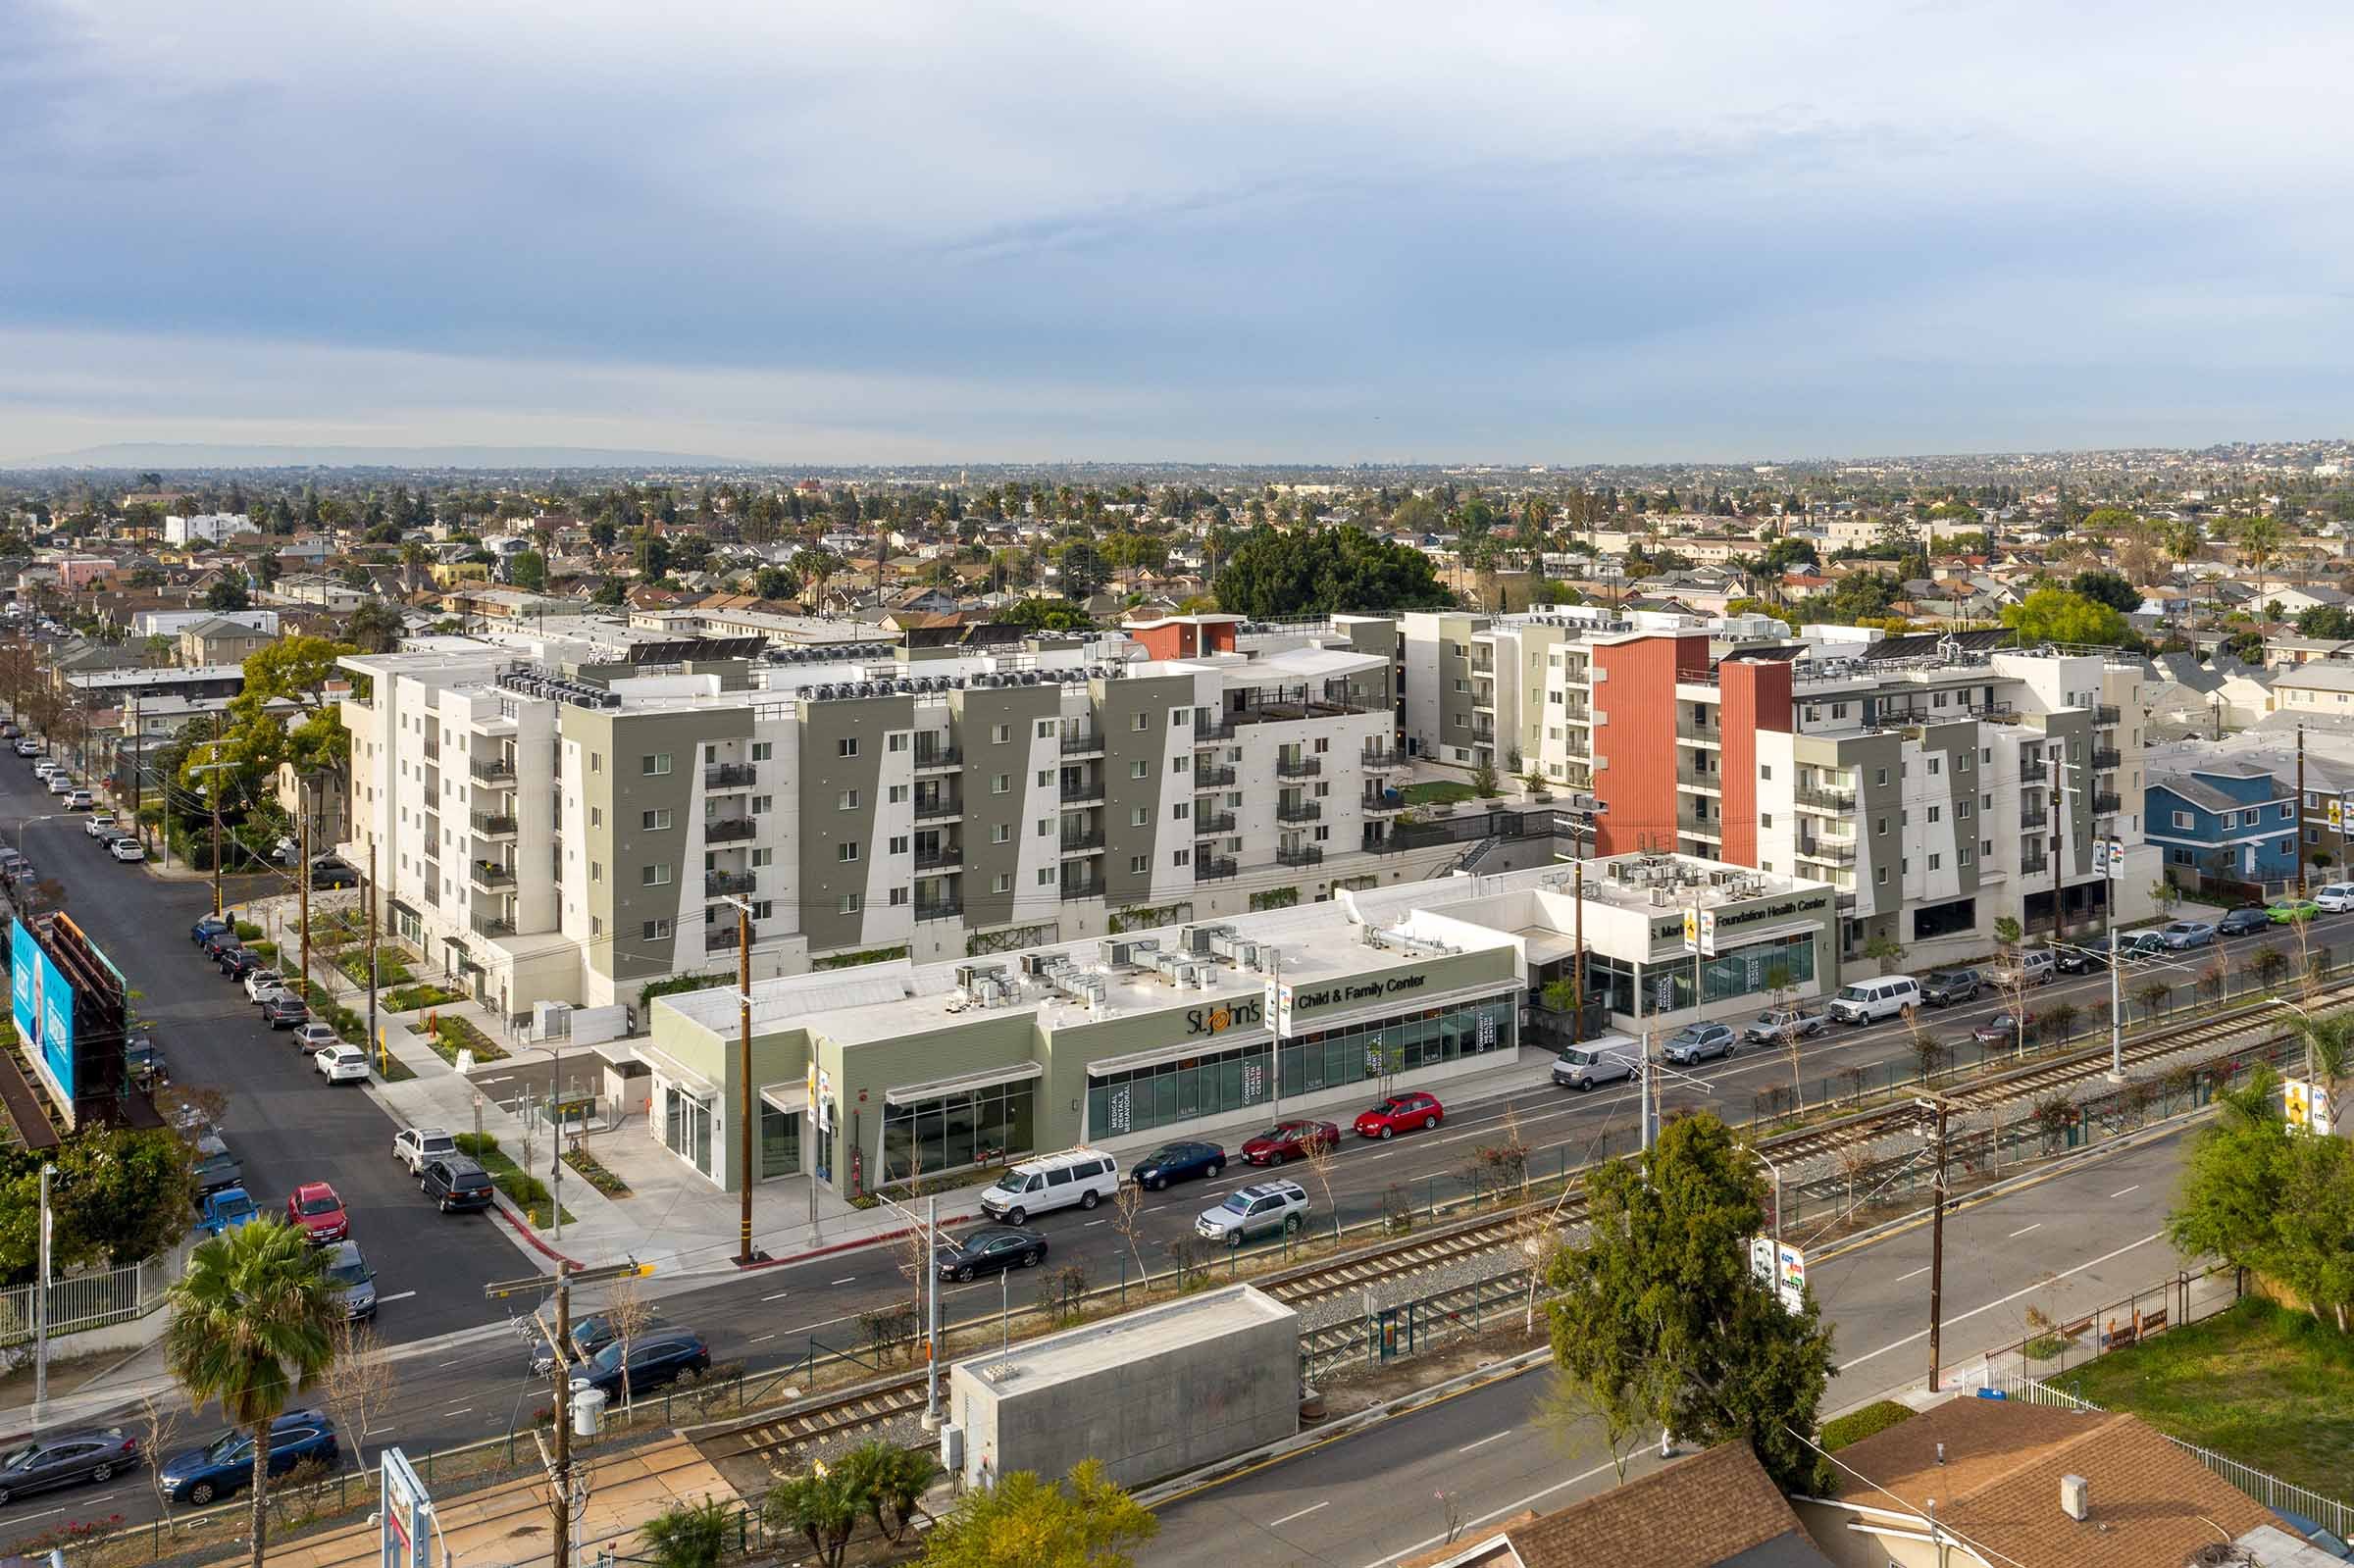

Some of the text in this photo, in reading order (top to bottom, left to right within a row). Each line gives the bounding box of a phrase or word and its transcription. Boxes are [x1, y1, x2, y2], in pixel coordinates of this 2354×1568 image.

[1715, 909, 1766, 928] Foundation
[1767, 902, 1796, 918] Health
[1798, 898, 1826, 912] Center
[1299, 990, 1329, 1009] Child
[1333, 988, 1342, 1002] &
[1346, 983, 1384, 997] Family
[1387, 976, 1426, 992] Center
[1187, 1010, 1206, 1035] St.
